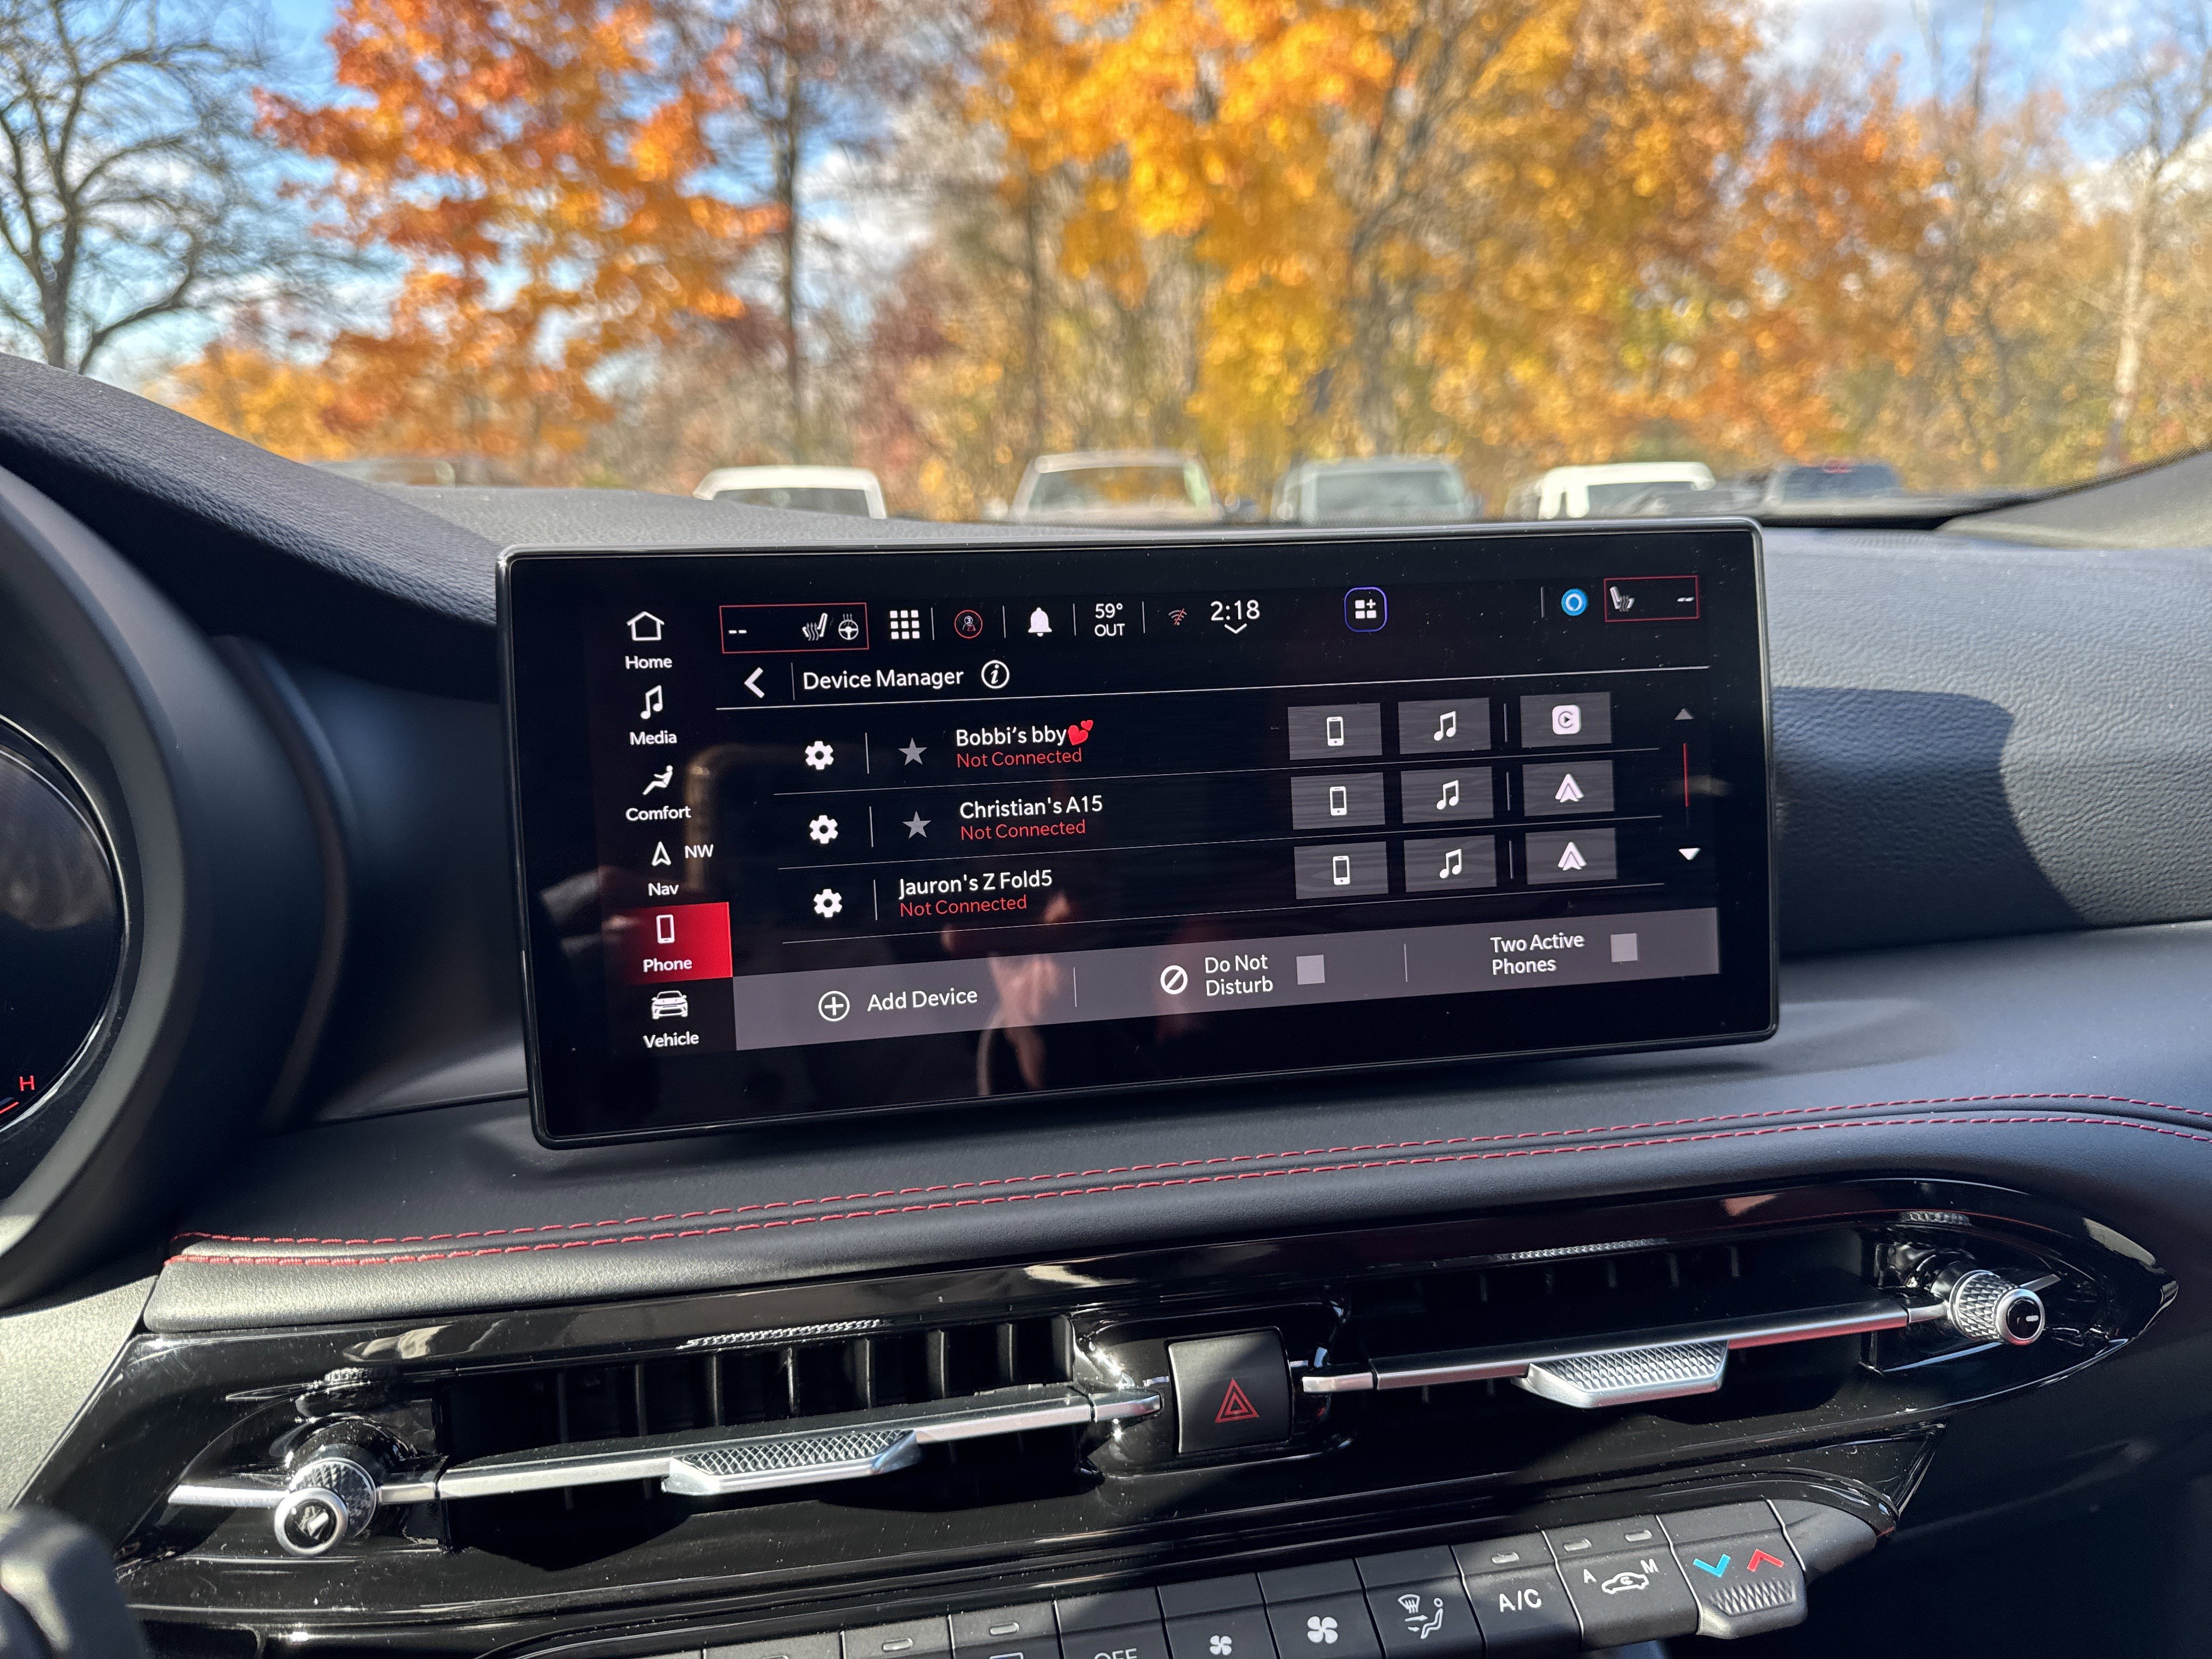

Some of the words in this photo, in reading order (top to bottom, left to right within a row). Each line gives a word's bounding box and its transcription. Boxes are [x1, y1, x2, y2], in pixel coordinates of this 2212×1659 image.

[1096, 603, 1122, 618] 59°
[1211, 600, 1260, 620] 2:18
[1094, 623, 1125, 636] OUT
[625, 656, 672, 669] Home
[804, 670, 871, 689] Device
[877, 670, 964, 689] Manager
[630, 730, 677, 745] Media
[957, 753, 988, 768] Not
[992, 748, 1081, 766] Connected
[626, 806, 691, 821] Comfort
[960, 798, 1062, 819] Christian's
[1066, 795, 1102, 812] A15
[961, 826, 991, 840] Not
[996, 819, 1085, 838] Connected
[685, 844, 713, 859] NW
[648, 883, 679, 896] Nav
[899, 875, 978, 899] Jauron's
[983, 873, 995, 890] Z
[1001, 870, 1052, 889] Fold5
[901, 902, 932, 917] Not
[936, 894, 1026, 914] Connected
[1490, 937, 1527, 952] Two
[1531, 932, 1585, 951] Active
[643, 958, 692, 973] Phone
[1205, 957, 1230, 973] Do
[1235, 955, 1268, 971] Not
[1493, 958, 1556, 975] Phones
[1206, 976, 1273, 996] Disturb
[867, 991, 906, 1011] Add
[912, 988, 977, 1008] Device
[643, 1031, 699, 1048] Vehicle
[20, 1075, 35, 1091] H
[1640, 1559, 1658, 1573] M
[1584, 1569, 1596, 1583] A
[1499, 1589, 1542, 1612] A/C
